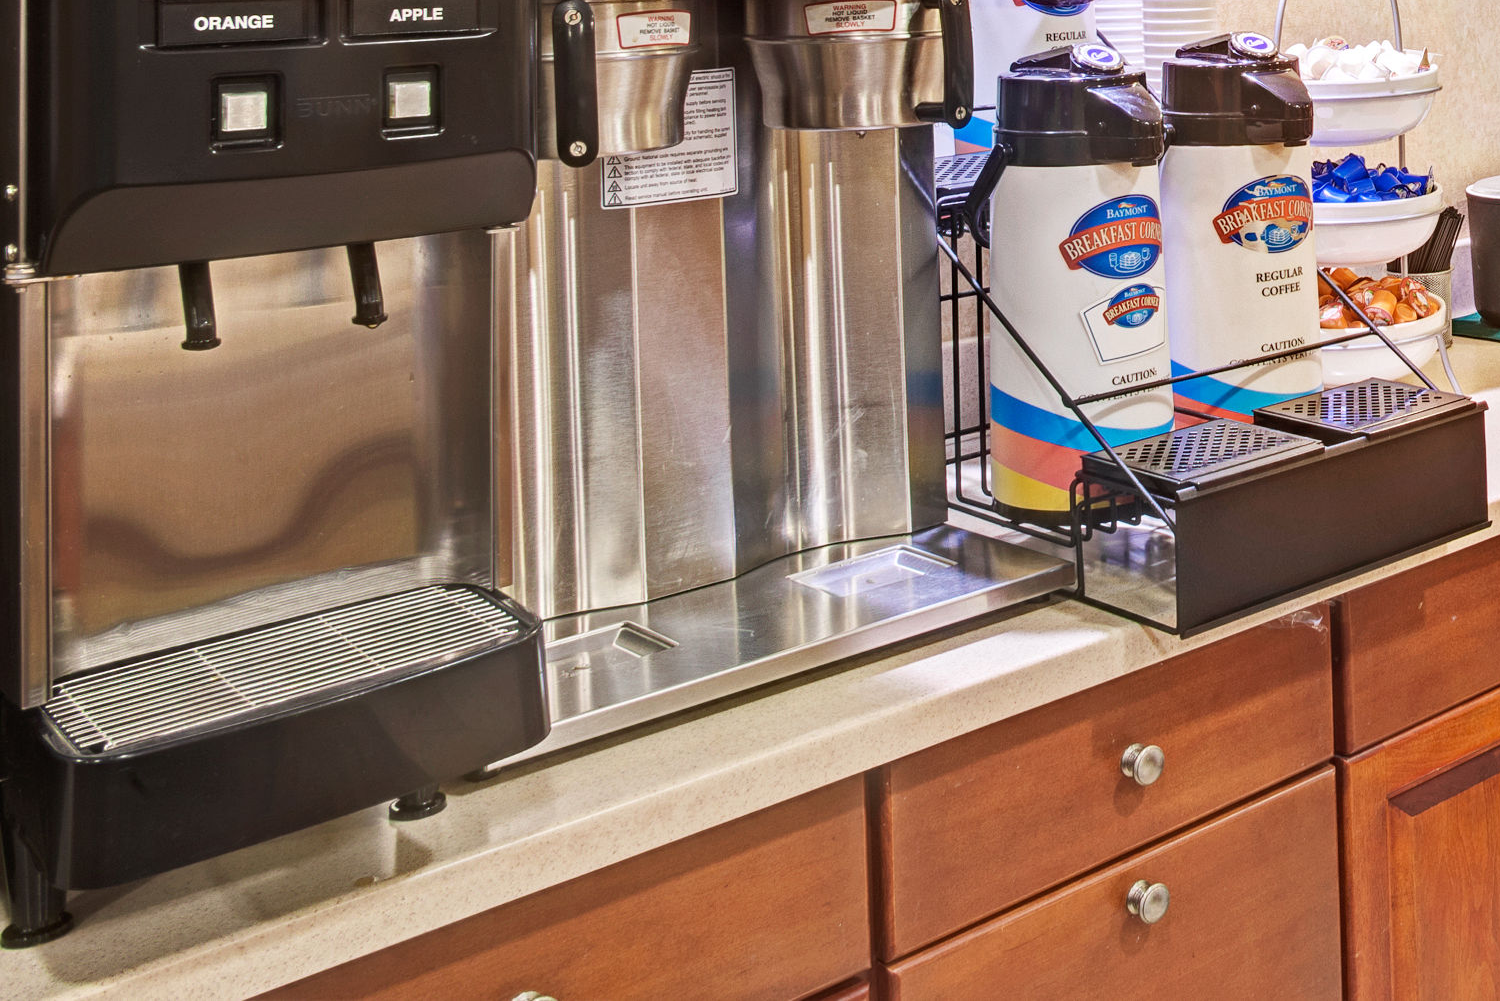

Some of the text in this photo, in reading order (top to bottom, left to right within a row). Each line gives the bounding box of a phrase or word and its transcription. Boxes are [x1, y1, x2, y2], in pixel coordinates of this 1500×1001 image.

[389, 7, 444, 23] APPLE
[833, 3, 867, 11] WARNING
[194, 14, 274, 31] ORANGE
[647, 15, 675, 23] WARNING
[835, 21, 866, 29] SLOWLY
[1045, 31, 1087, 42] REGULAR
[1257, 184, 1298, 197] BAYMONT
[1106, 204, 1148, 220] BAYMONT
[1216, 199, 1286, 237] BREAKFAST
[1064, 222, 1137, 261] BREAKFAST
[1256, 266, 1304, 283] REGULAR
[1124, 287, 1146, 298] BAYMONT
[1261, 281, 1301, 297] COFFEE
[1105, 296, 1160, 321] BREAKFAST CORNER
[1261, 336, 1305, 353] CAUTION:
[1111, 367, 1157, 386] CAUTION:
